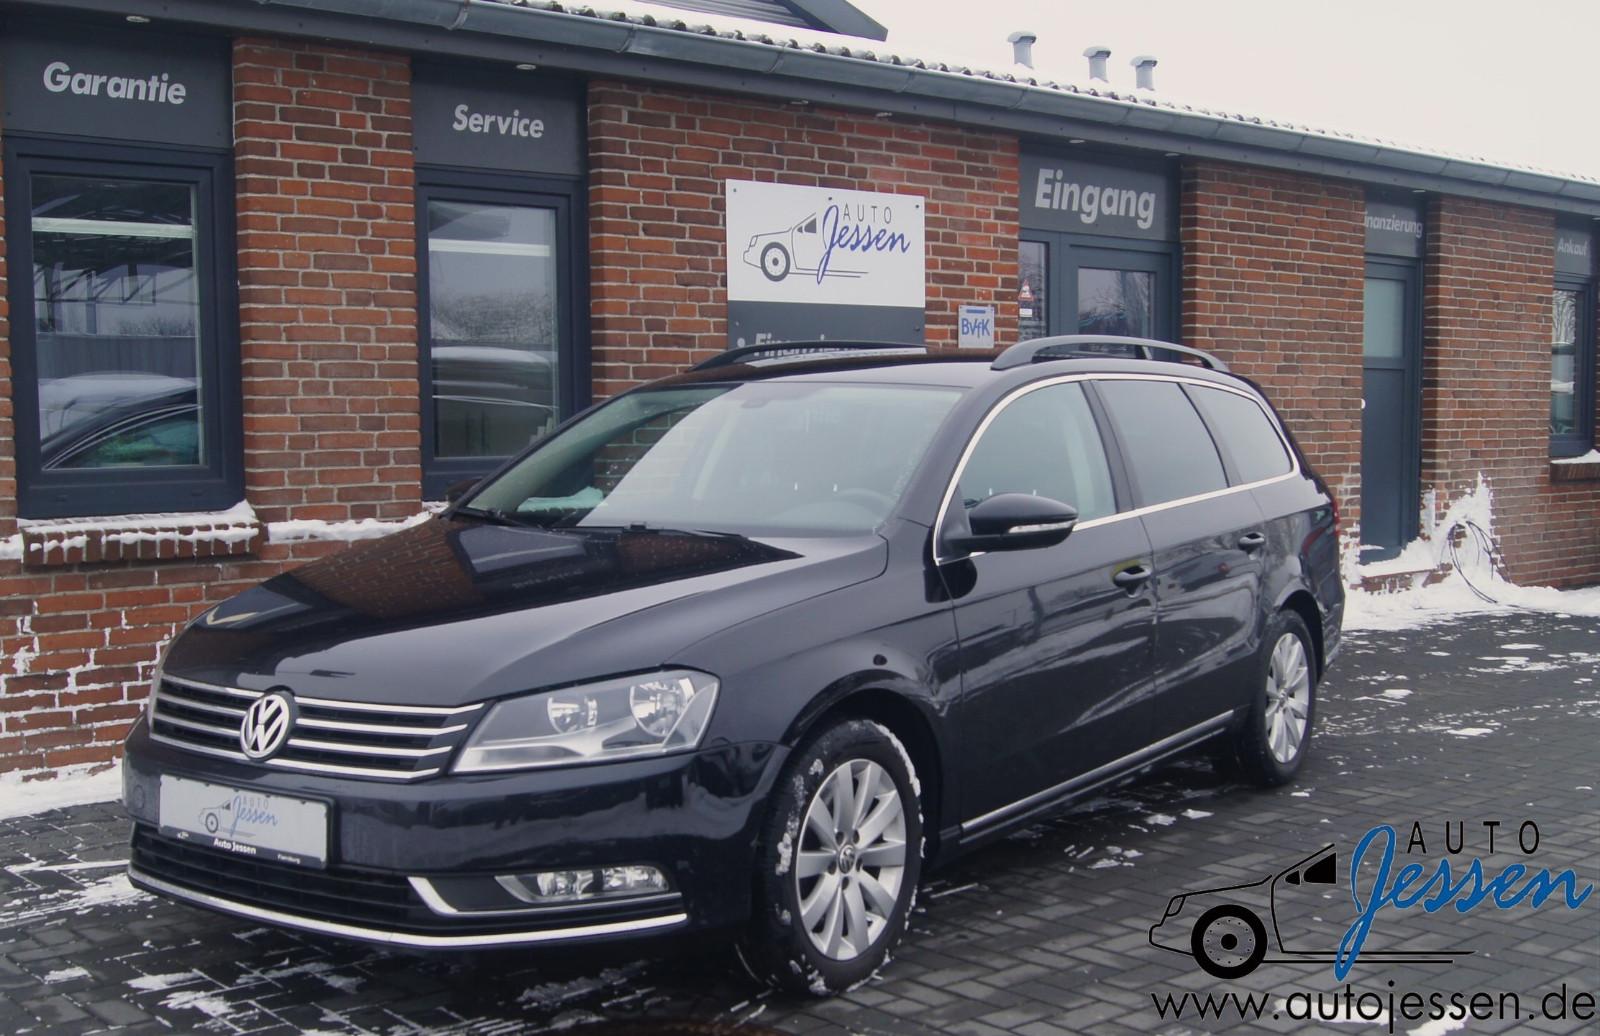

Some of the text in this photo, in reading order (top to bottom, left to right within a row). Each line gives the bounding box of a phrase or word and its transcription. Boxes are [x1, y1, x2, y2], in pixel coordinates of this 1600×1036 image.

[43, 61, 187, 105] Garantie
[452, 103, 545, 140] Service
[842, 203, 892, 224] AUTO
[1035, 168, 1156, 230] Eingang
[816, 204, 911, 285] Jessen
[230, 794, 279, 838] Jessen
[213, 837, 257, 855] Auto Jessen
